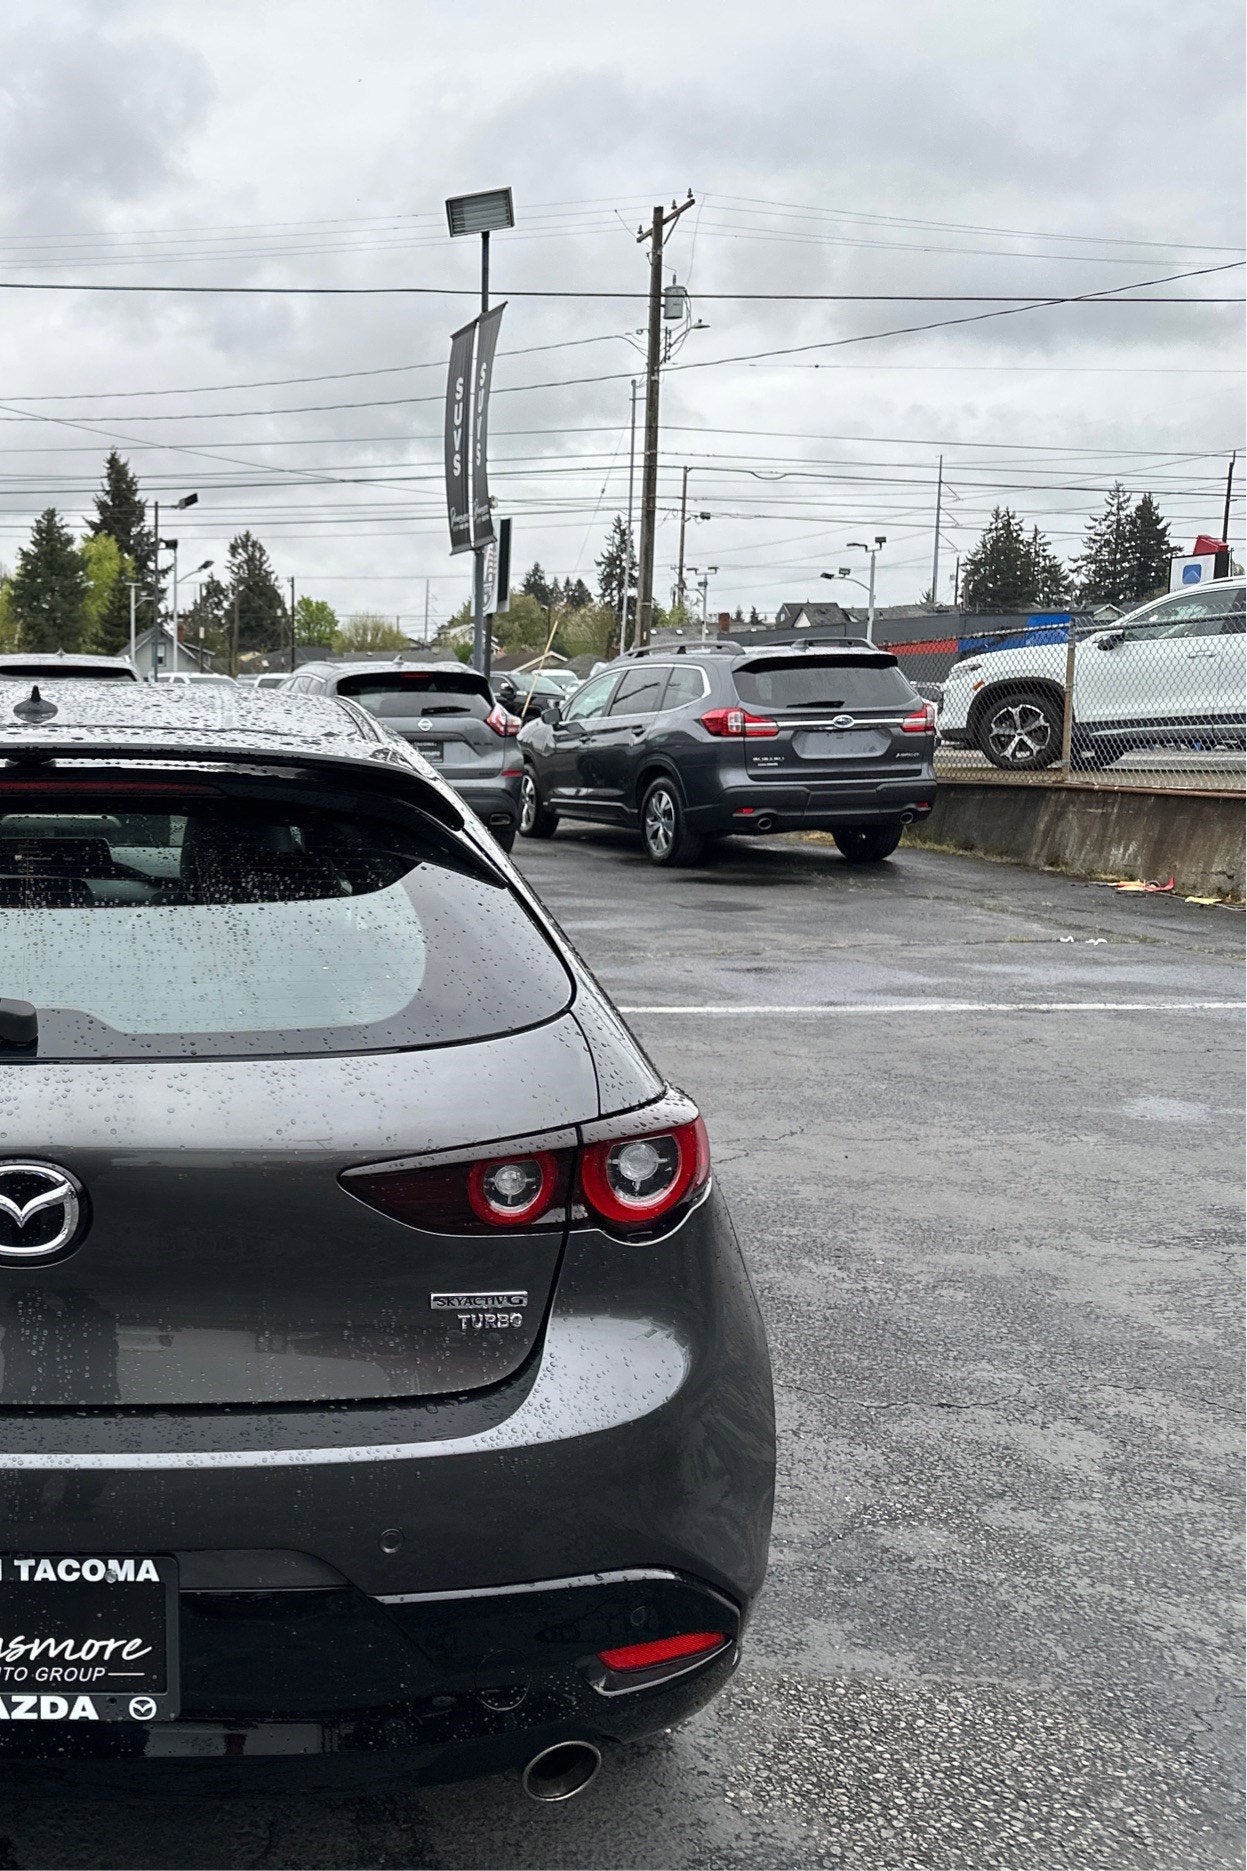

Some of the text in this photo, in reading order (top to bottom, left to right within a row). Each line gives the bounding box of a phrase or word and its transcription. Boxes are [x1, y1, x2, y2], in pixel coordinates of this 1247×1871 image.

[453, 376, 464, 477] SUVS
[457, 1312, 523, 1330] TURBO
[14, 1559, 160, 1582] TACOMA
[35, 1666, 106, 1682] GROUP
